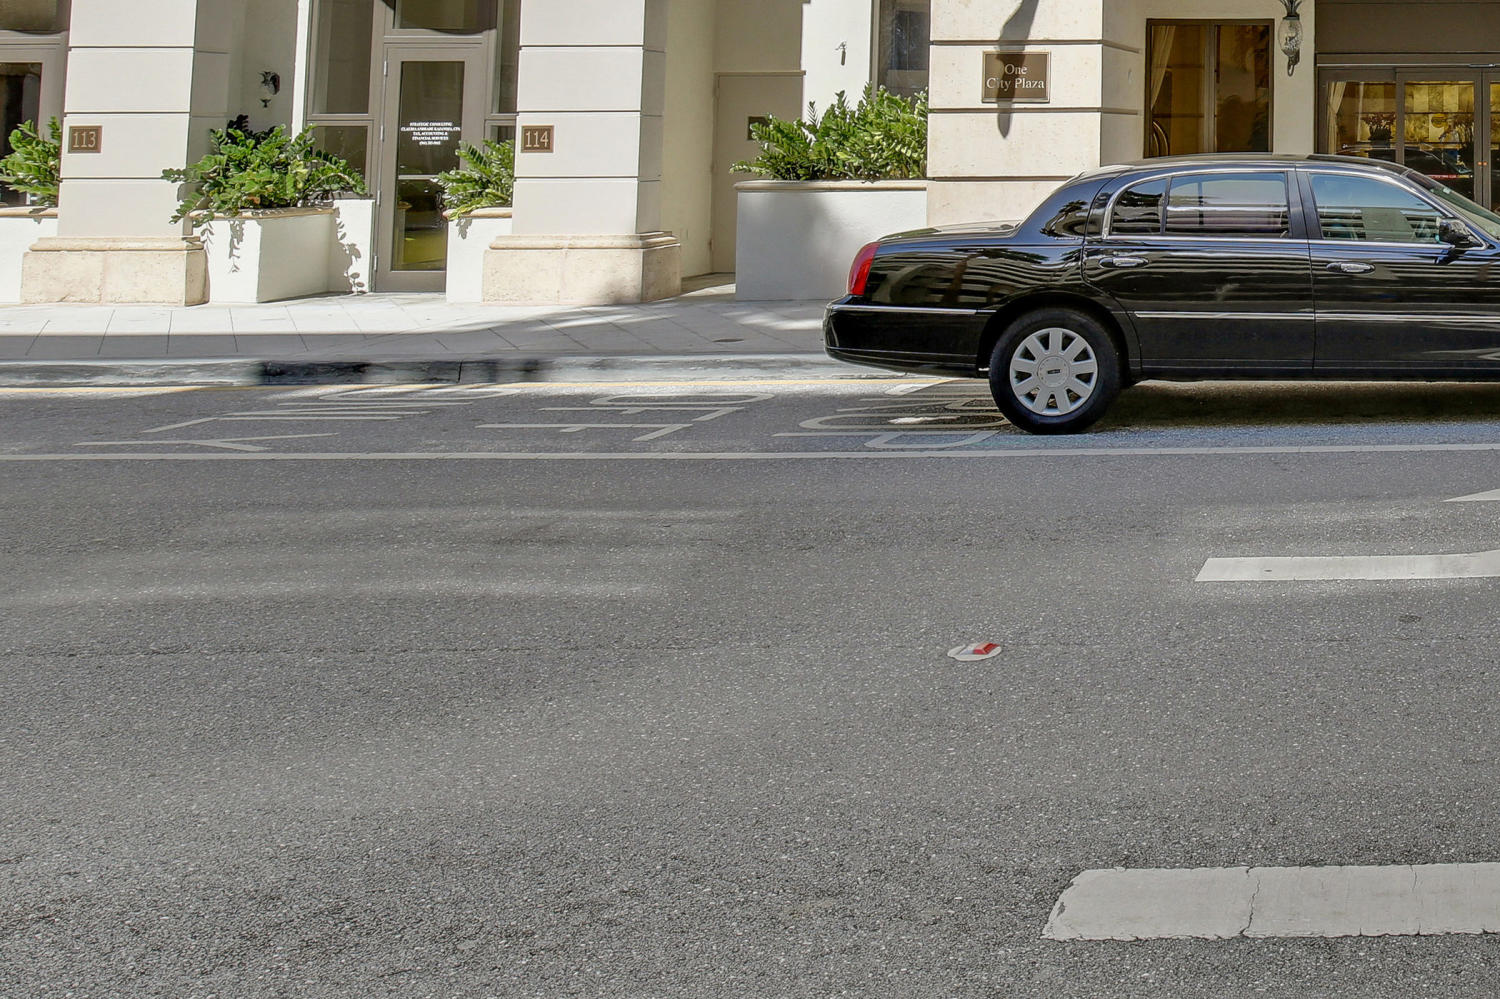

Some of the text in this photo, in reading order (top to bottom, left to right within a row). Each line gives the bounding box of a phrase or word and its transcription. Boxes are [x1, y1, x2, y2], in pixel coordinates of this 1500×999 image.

[1004, 63, 1028, 75] One
[986, 77, 1045, 92] City Plaza
[72, 131, 96, 148] 113
[525, 130, 549, 148] 114
[73, 388, 520, 451] ONLY
